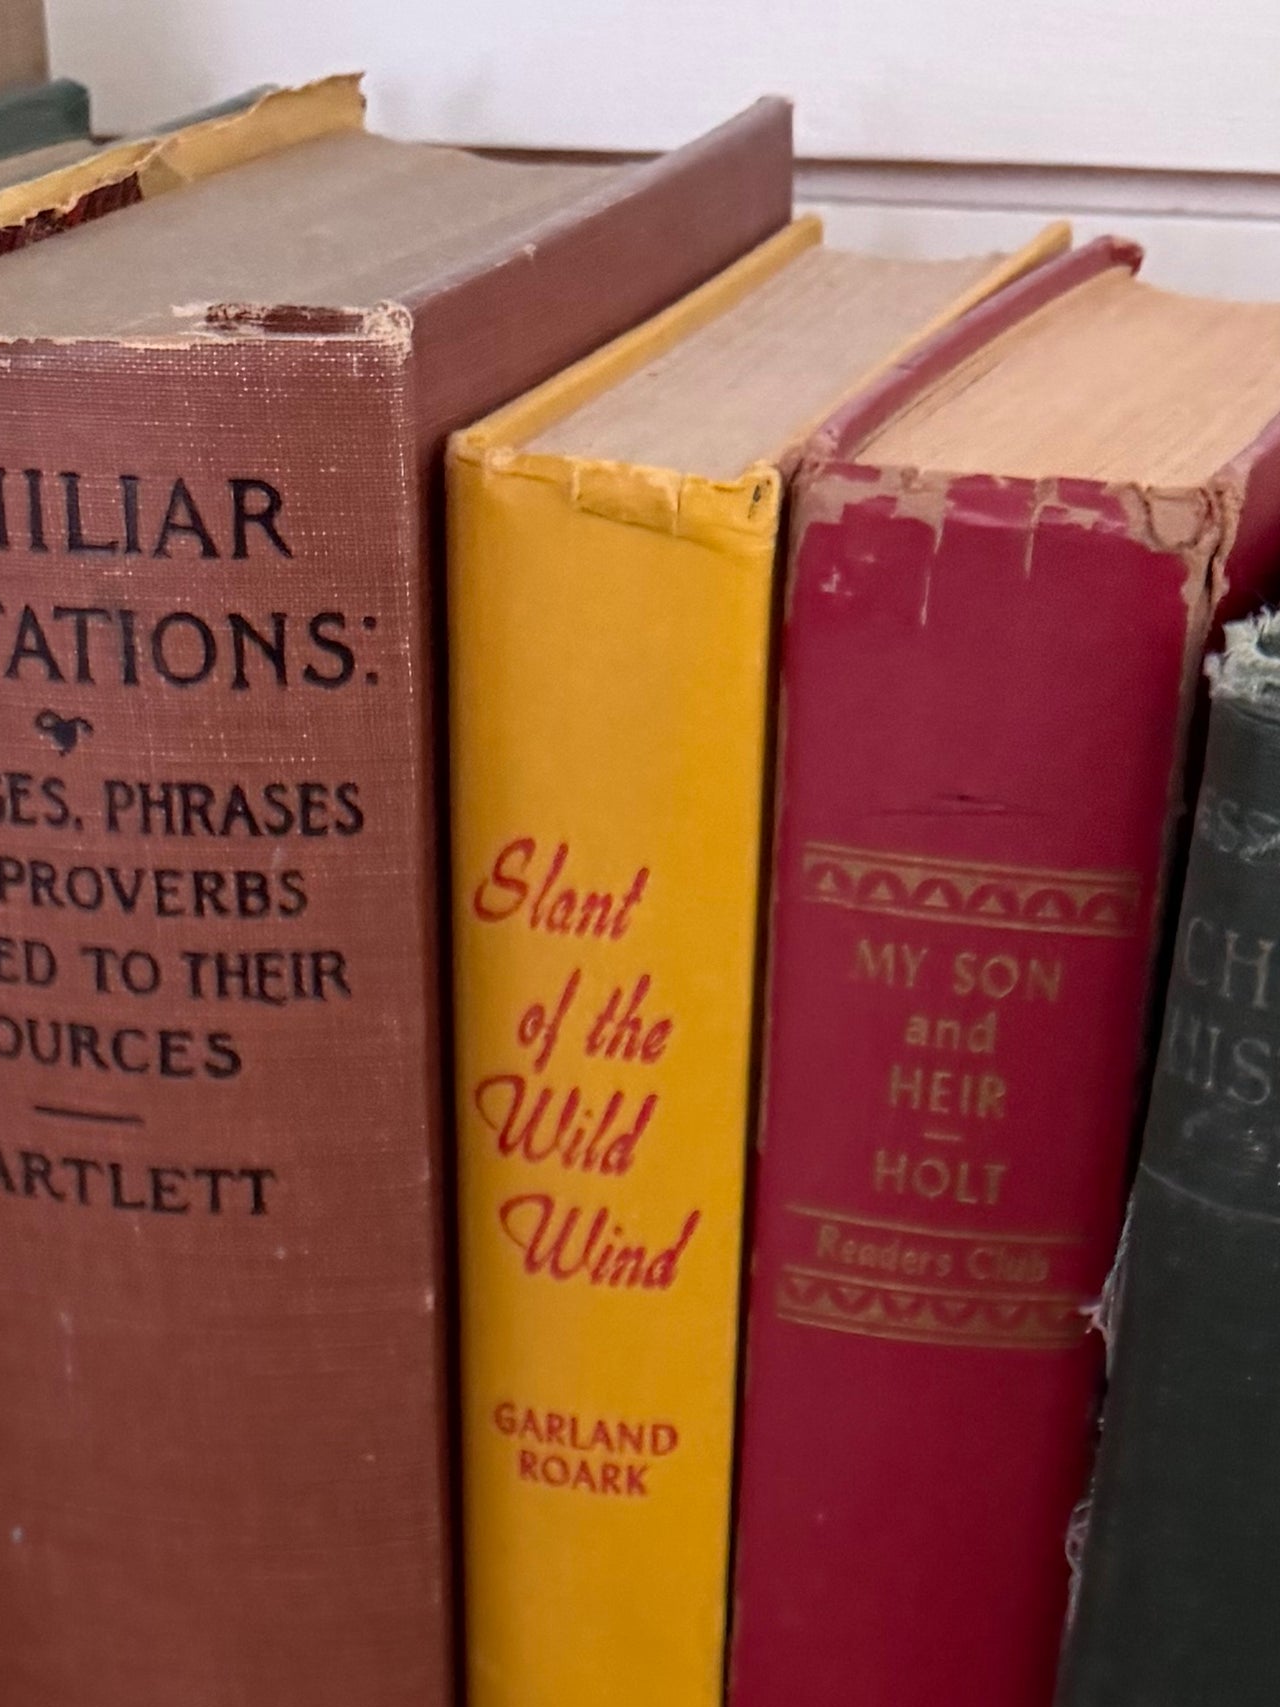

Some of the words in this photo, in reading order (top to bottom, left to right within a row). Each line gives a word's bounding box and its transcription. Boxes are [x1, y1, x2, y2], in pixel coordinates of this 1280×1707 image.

[105, 780, 365, 837] PHRASES
[473, 837, 650, 942] Slant
[81, 946, 162, 995] TO
[182, 949, 352, 1006] THEIR
[852, 938, 929, 989] MY
[952, 950, 1063, 1002] SON
[518, 967, 582, 1073] of
[584, 973, 674, 1065] the
[904, 1010, 998, 1055] and
[888, 1064, 1008, 1120] HEIR
[474, 1074, 659, 1178] Wild
[871, 1148, 1007, 1206] HOLT
[499, 1193, 703, 1292] Wind
[817, 1223, 955, 1280] Readers
[492, 1401, 679, 1457] GARLAND
[518, 1448, 650, 1498] ROARK
